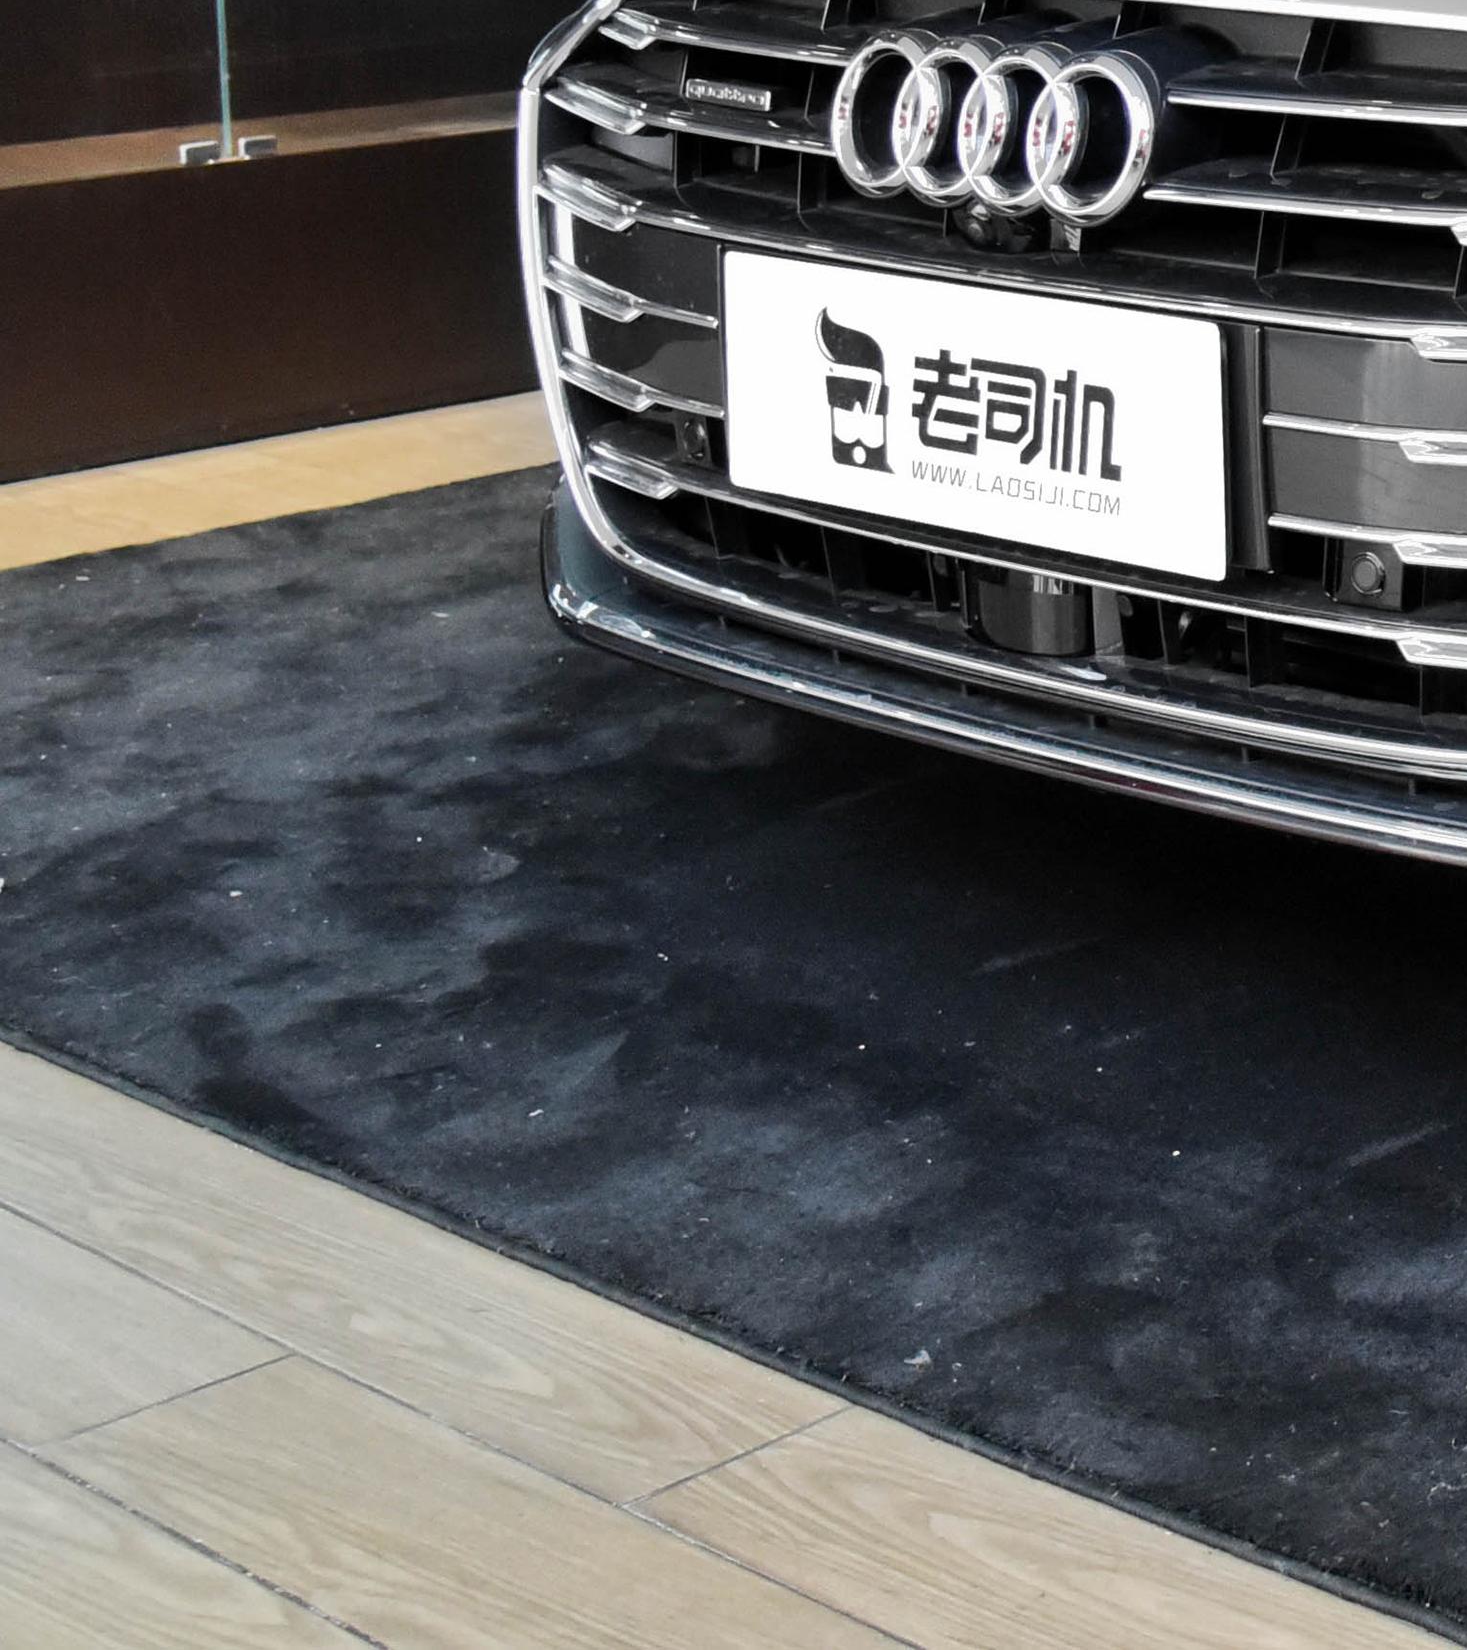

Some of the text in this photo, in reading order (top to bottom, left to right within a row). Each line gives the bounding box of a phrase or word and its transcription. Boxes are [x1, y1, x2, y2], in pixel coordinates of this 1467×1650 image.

[689, 84, 766, 106] quattro
[911, 349, 1122, 482] 老司机
[911, 460, 1121, 516] WWW.LAOSIJI.COM
